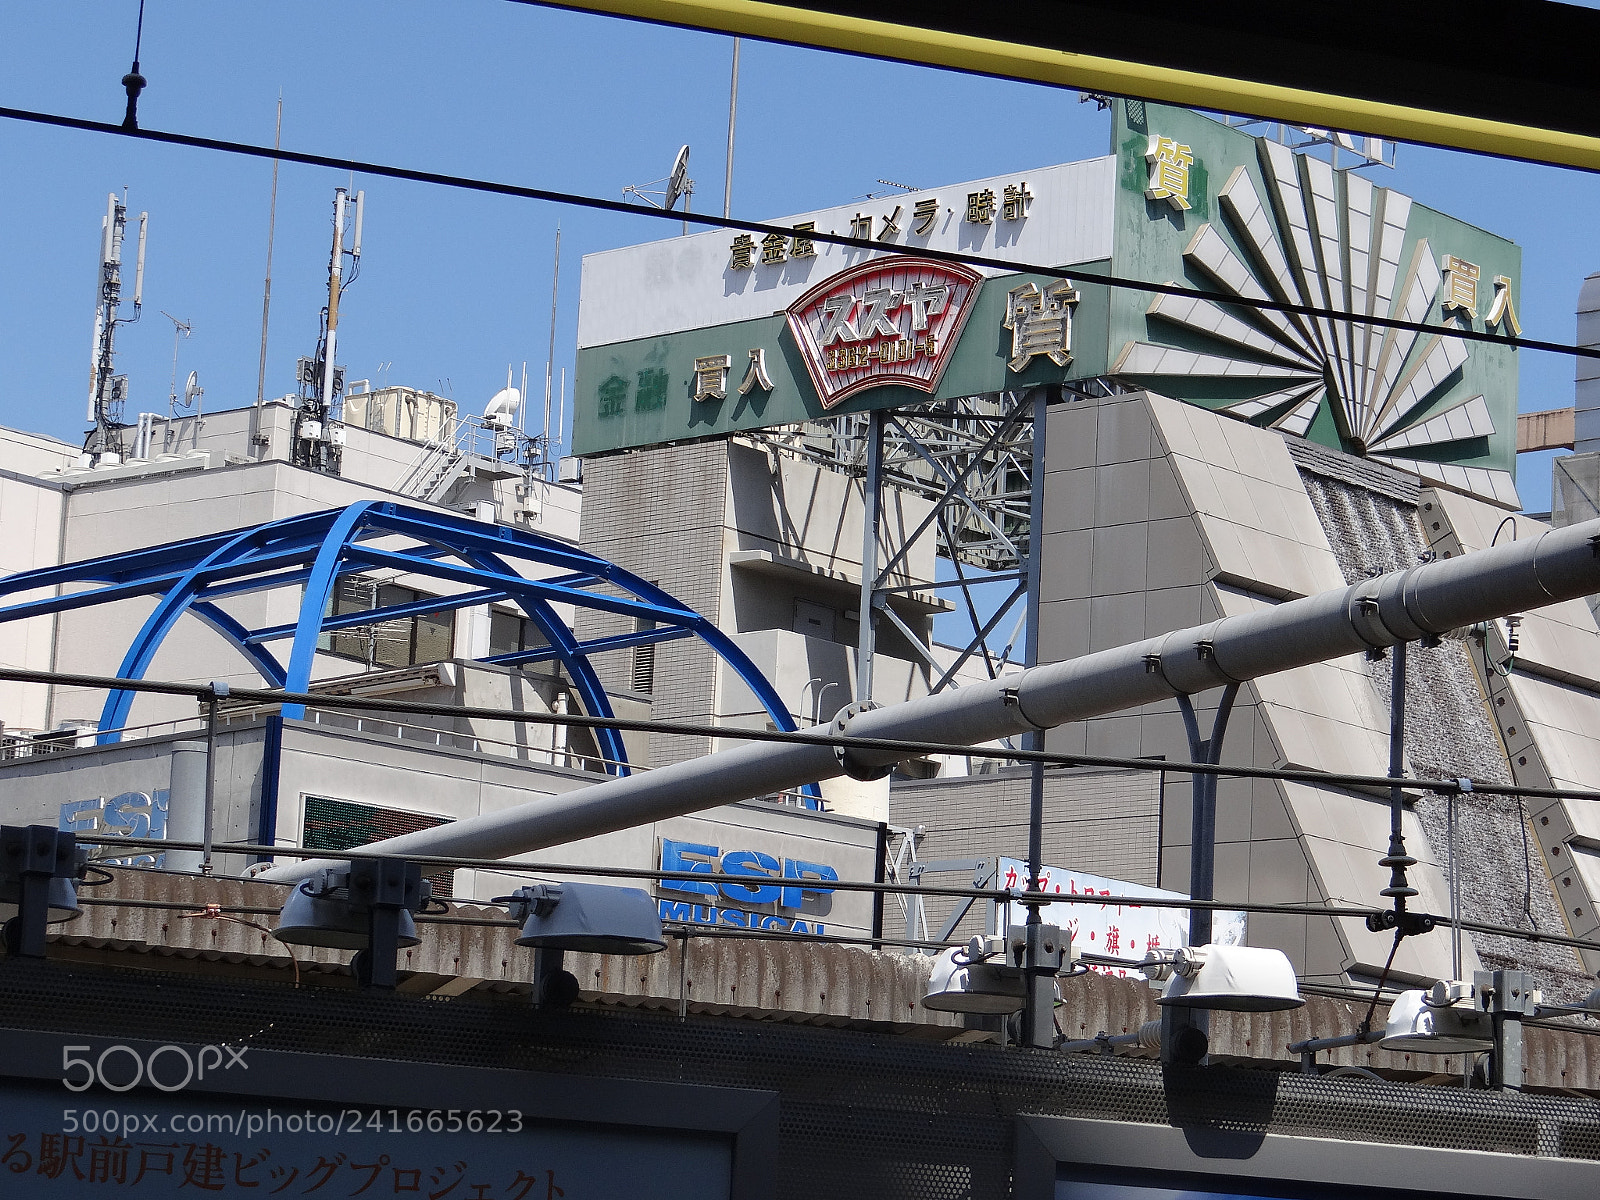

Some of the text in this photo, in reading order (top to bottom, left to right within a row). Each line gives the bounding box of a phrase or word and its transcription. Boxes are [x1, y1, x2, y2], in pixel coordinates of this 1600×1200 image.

[1144, 134, 1194, 211] 質
[821, 281, 950, 346] スズヤ
[1003, 278, 1081, 373] 質
[660, 838, 839, 908] ESP
[3, 1132, 565, 1200] る駅前戸建ビッグプロジェクト
